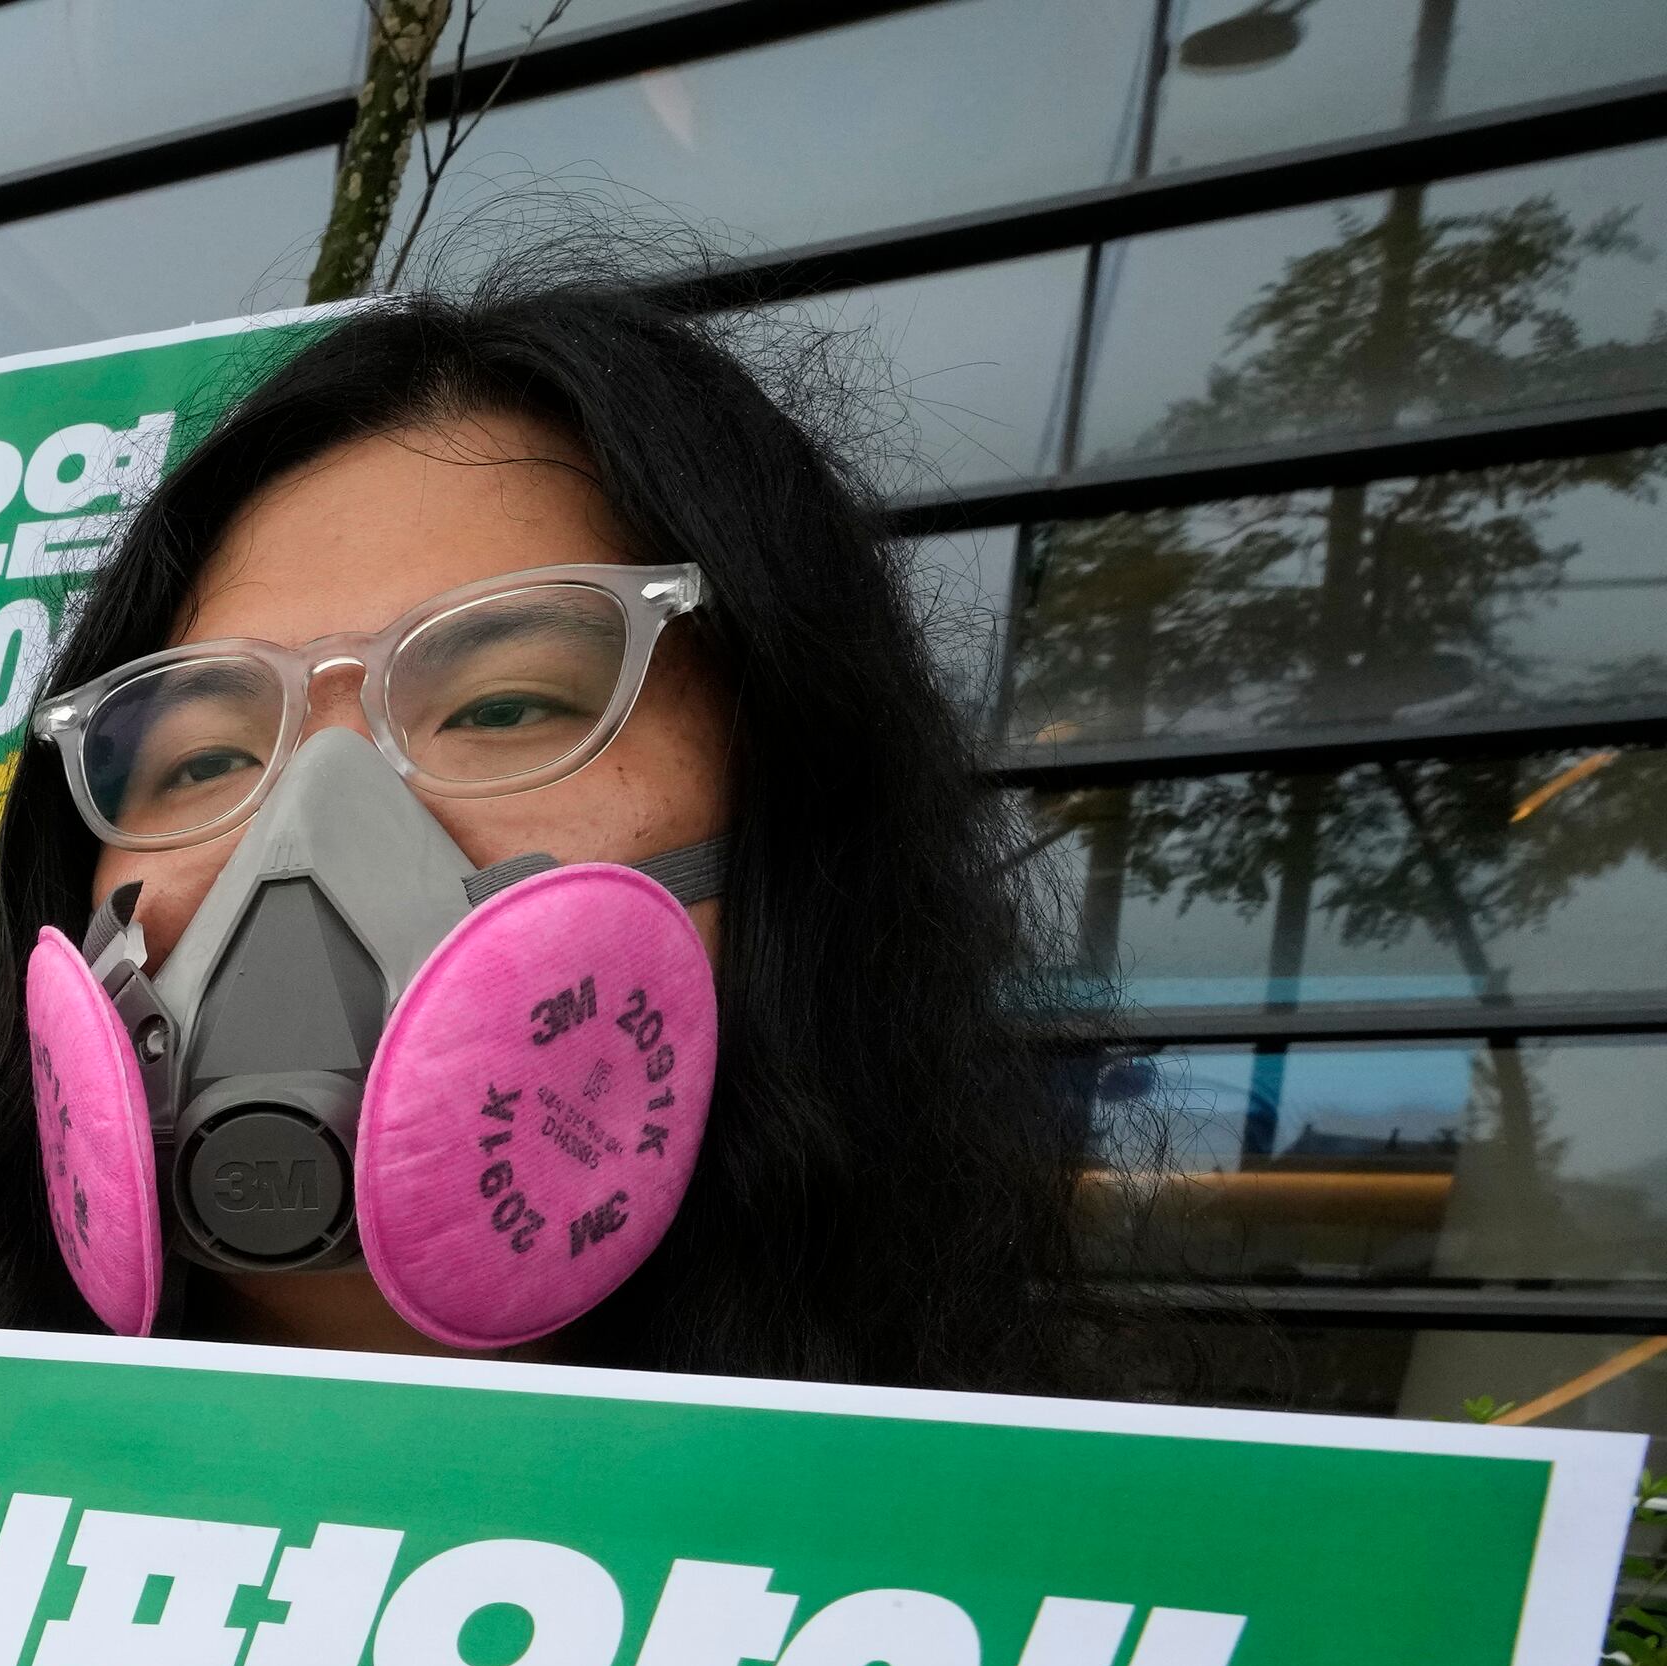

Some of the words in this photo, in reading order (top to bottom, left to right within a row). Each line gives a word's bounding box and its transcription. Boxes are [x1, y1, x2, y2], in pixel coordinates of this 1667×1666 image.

[531, 976, 597, 1046] 3M
[616, 988, 676, 1159] 2091K
[214, 1160, 320, 1212] 3M
[479, 1081, 546, 1254] 2091K
[569, 1190, 630, 1259] 3M
